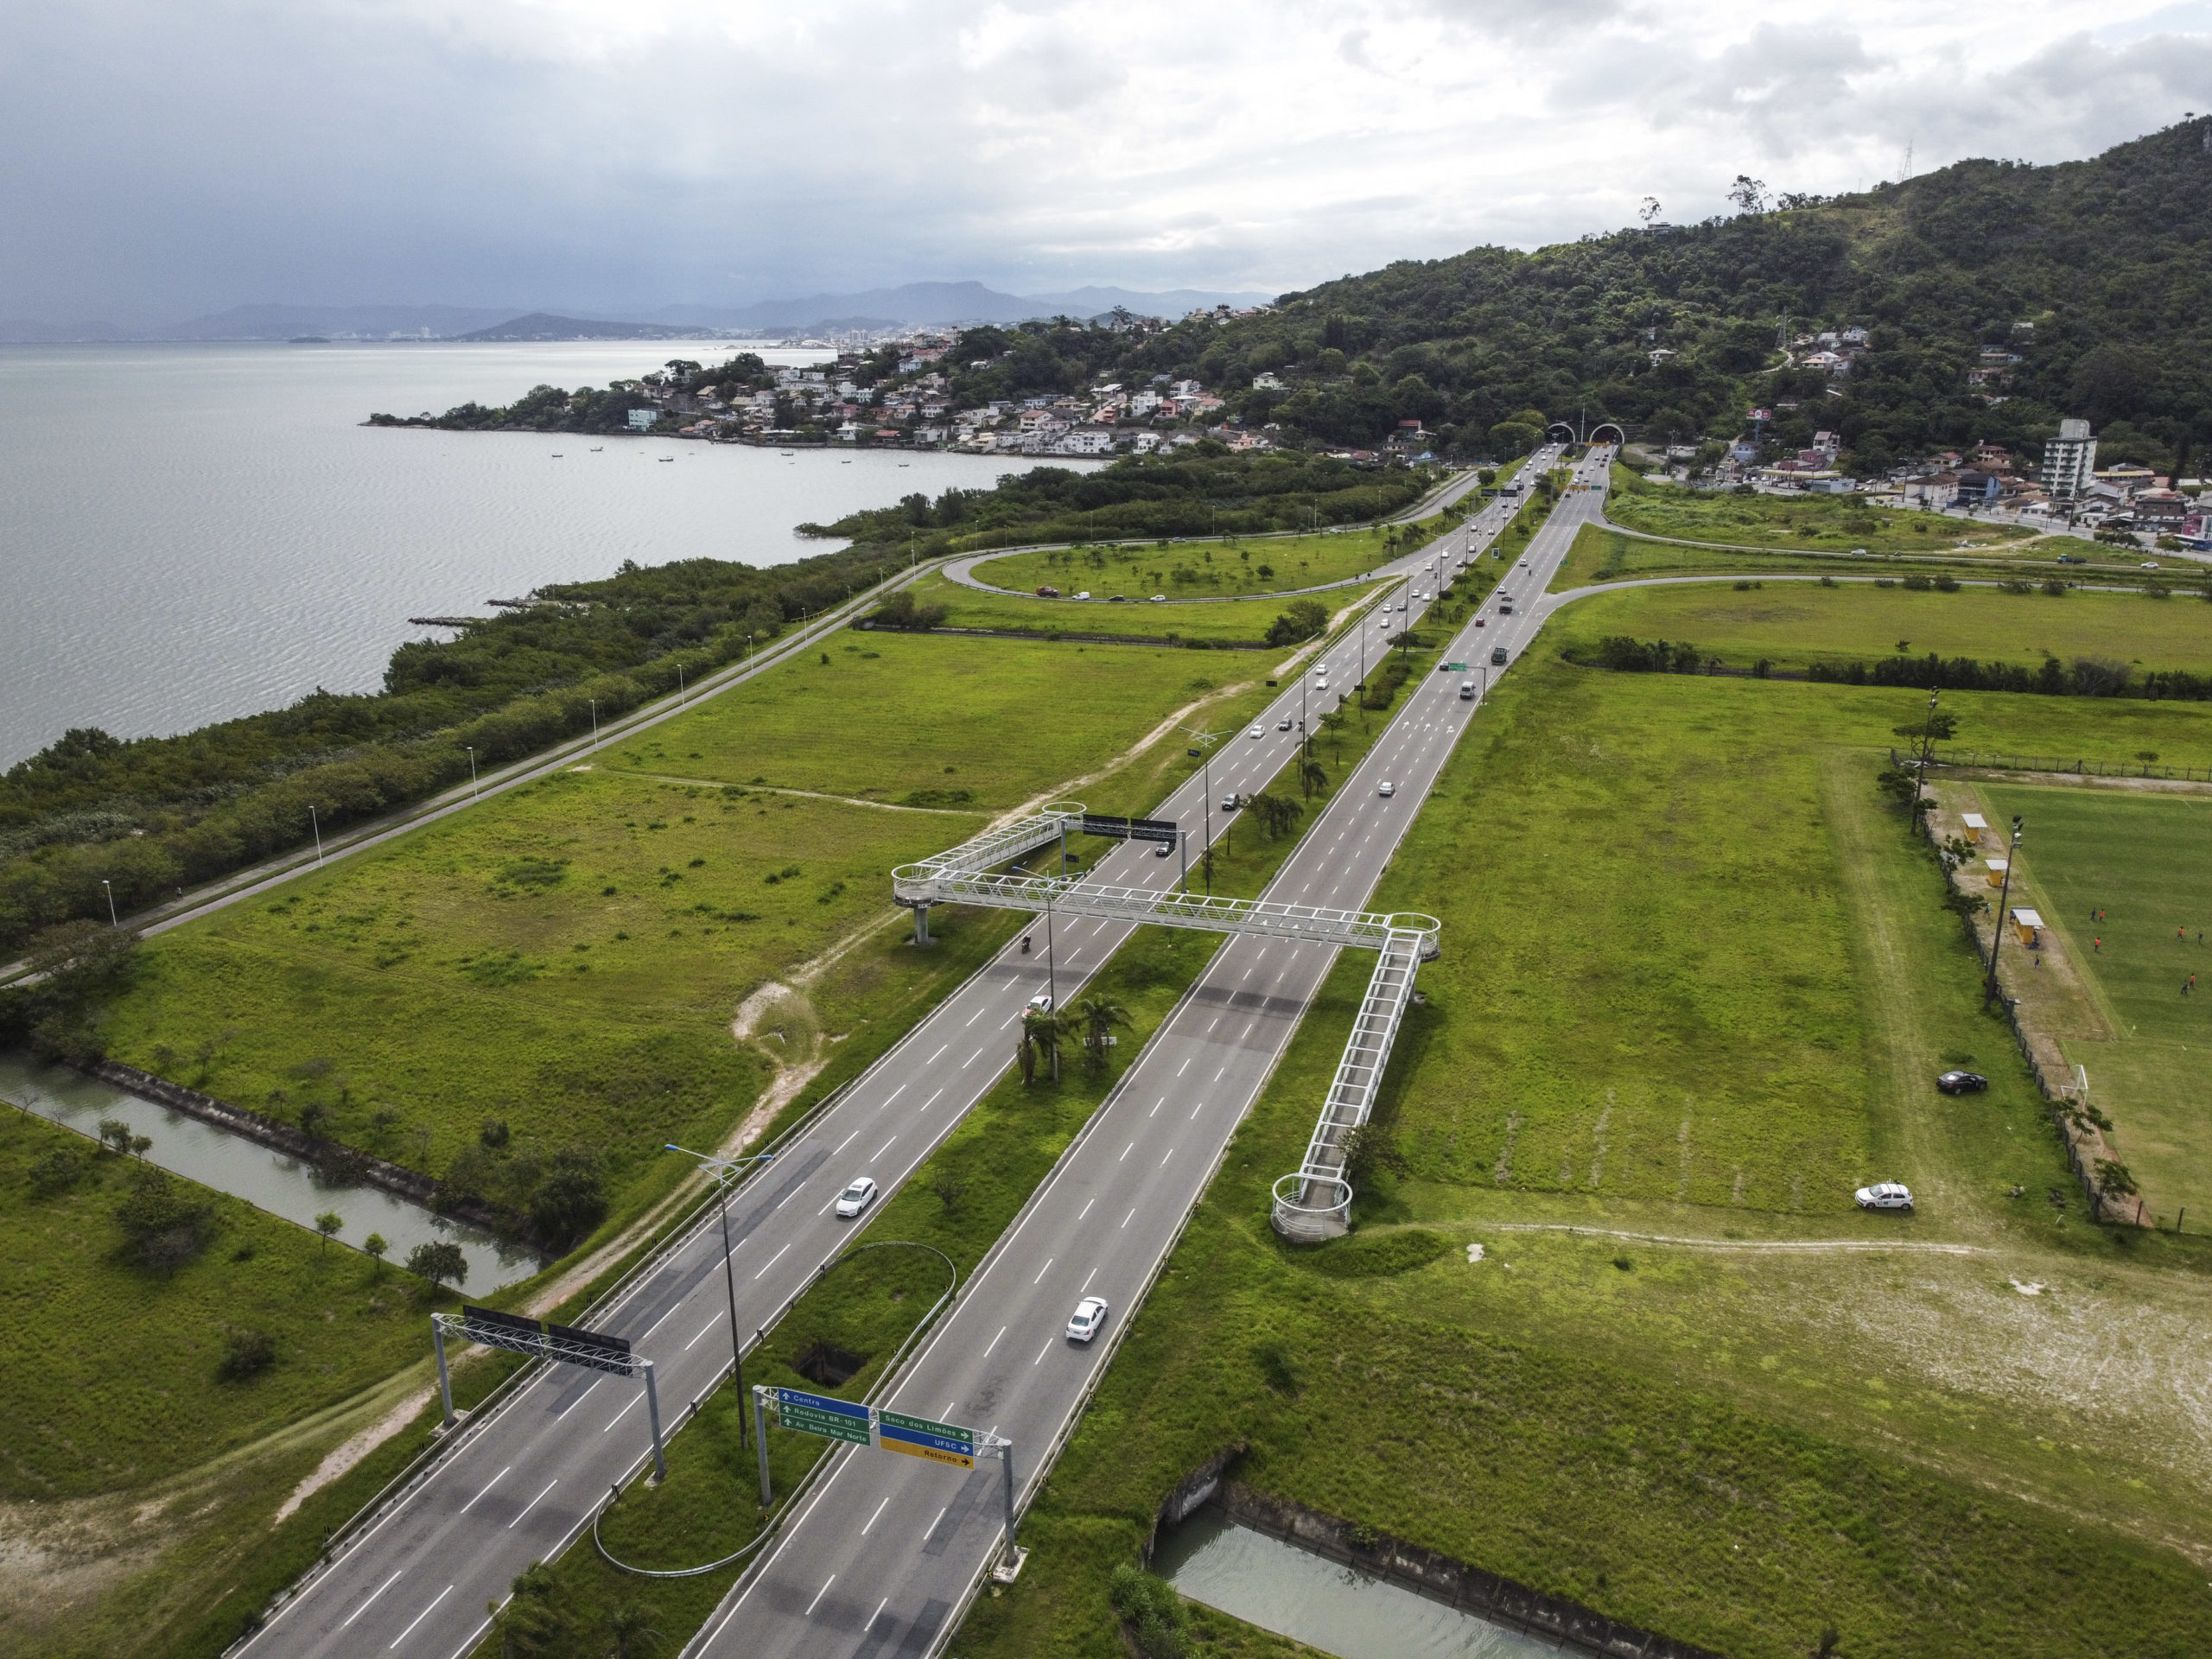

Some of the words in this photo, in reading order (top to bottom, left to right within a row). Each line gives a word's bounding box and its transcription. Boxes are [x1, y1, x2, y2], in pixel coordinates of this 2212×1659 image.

[793, 1395, 820, 1406] Centro
[794, 1408, 825, 1420] Rodovia
[829, 1415, 856, 1427] BR-101
[885, 1414, 905, 1425] Saco
[908, 1421, 923, 1429] dos
[926, 1424, 957, 1436] Limões
[809, 1424, 827, 1433] Beira
[847, 1433, 867, 1442] Norte
[934, 1439, 957, 1449] UFSC
[924, 1450, 957, 1463] Retorno
